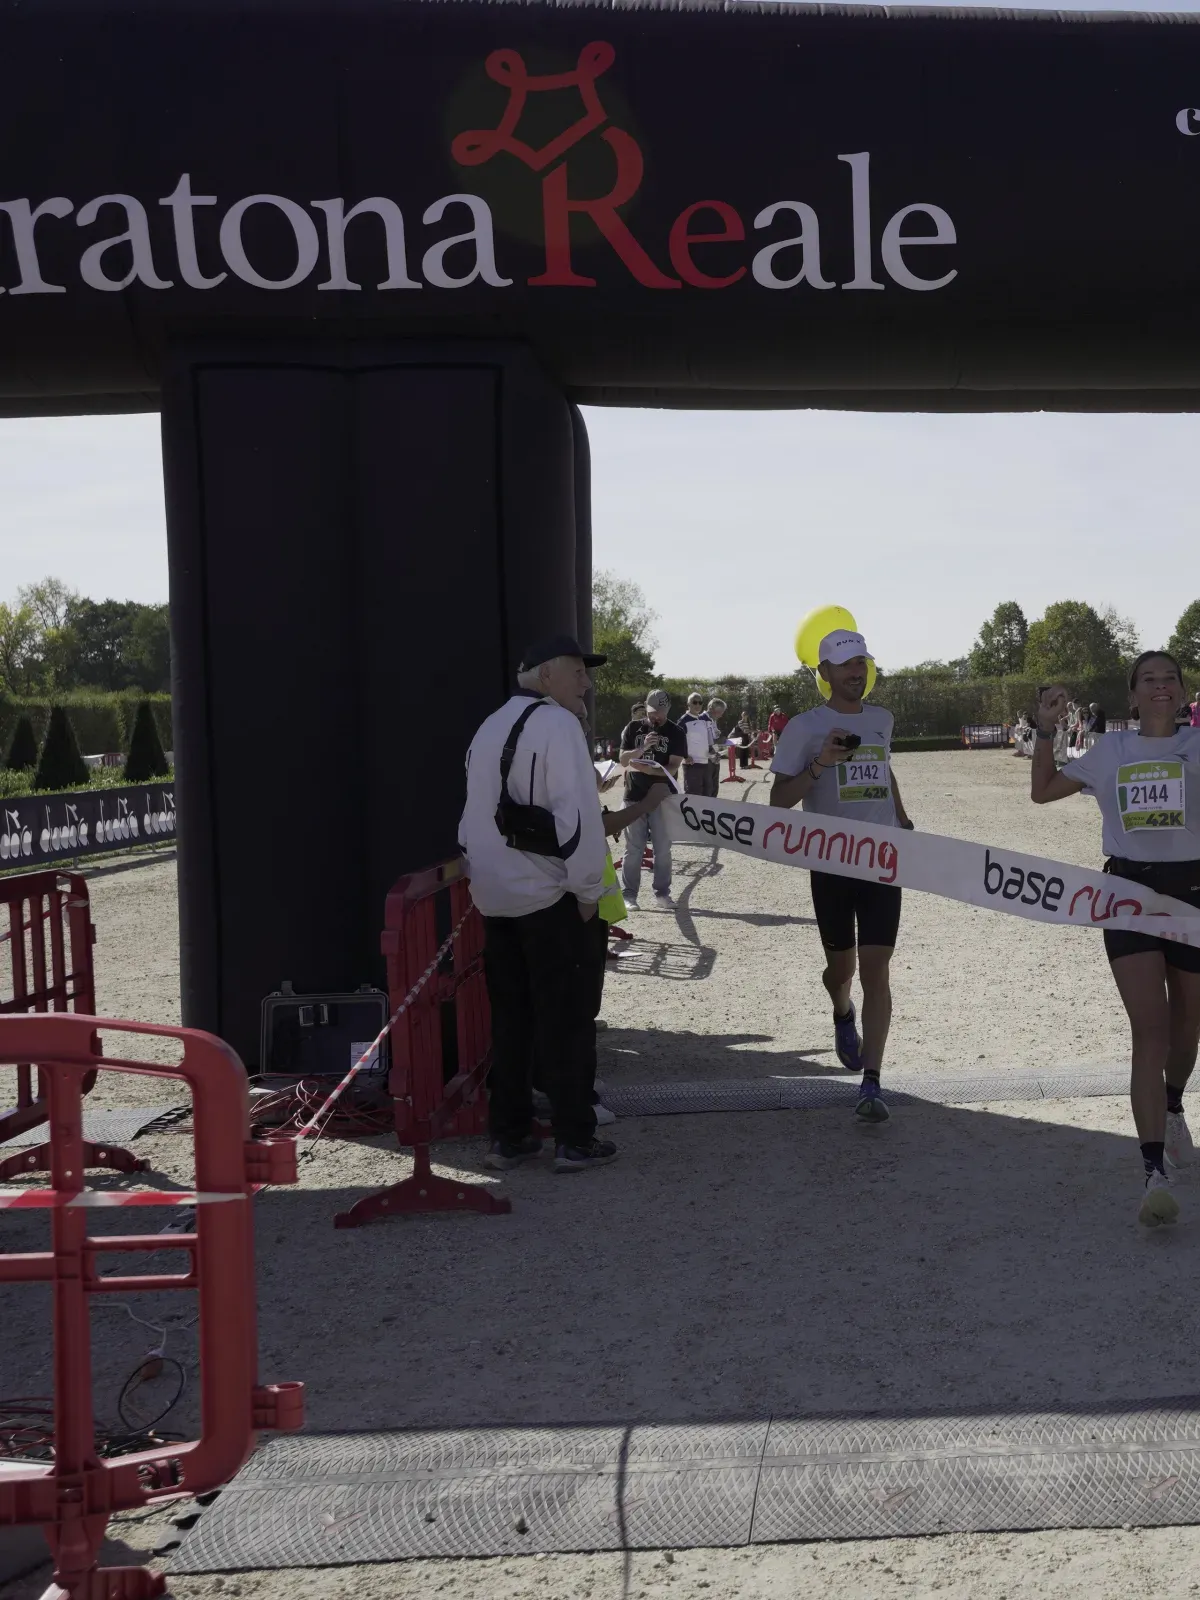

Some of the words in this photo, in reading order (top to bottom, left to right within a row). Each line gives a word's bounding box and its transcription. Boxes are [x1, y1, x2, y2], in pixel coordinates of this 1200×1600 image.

[0, 172, 514, 294] ratona
[850, 765, 879, 781] 2142
[862, 787, 888, 799] 42K
[1130, 784, 1169, 805] 2144
[1145, 811, 1183, 827] 42K
[679, 796, 756, 846] base
[762, 821, 899, 884] running
[983, 849, 1065, 912] base
